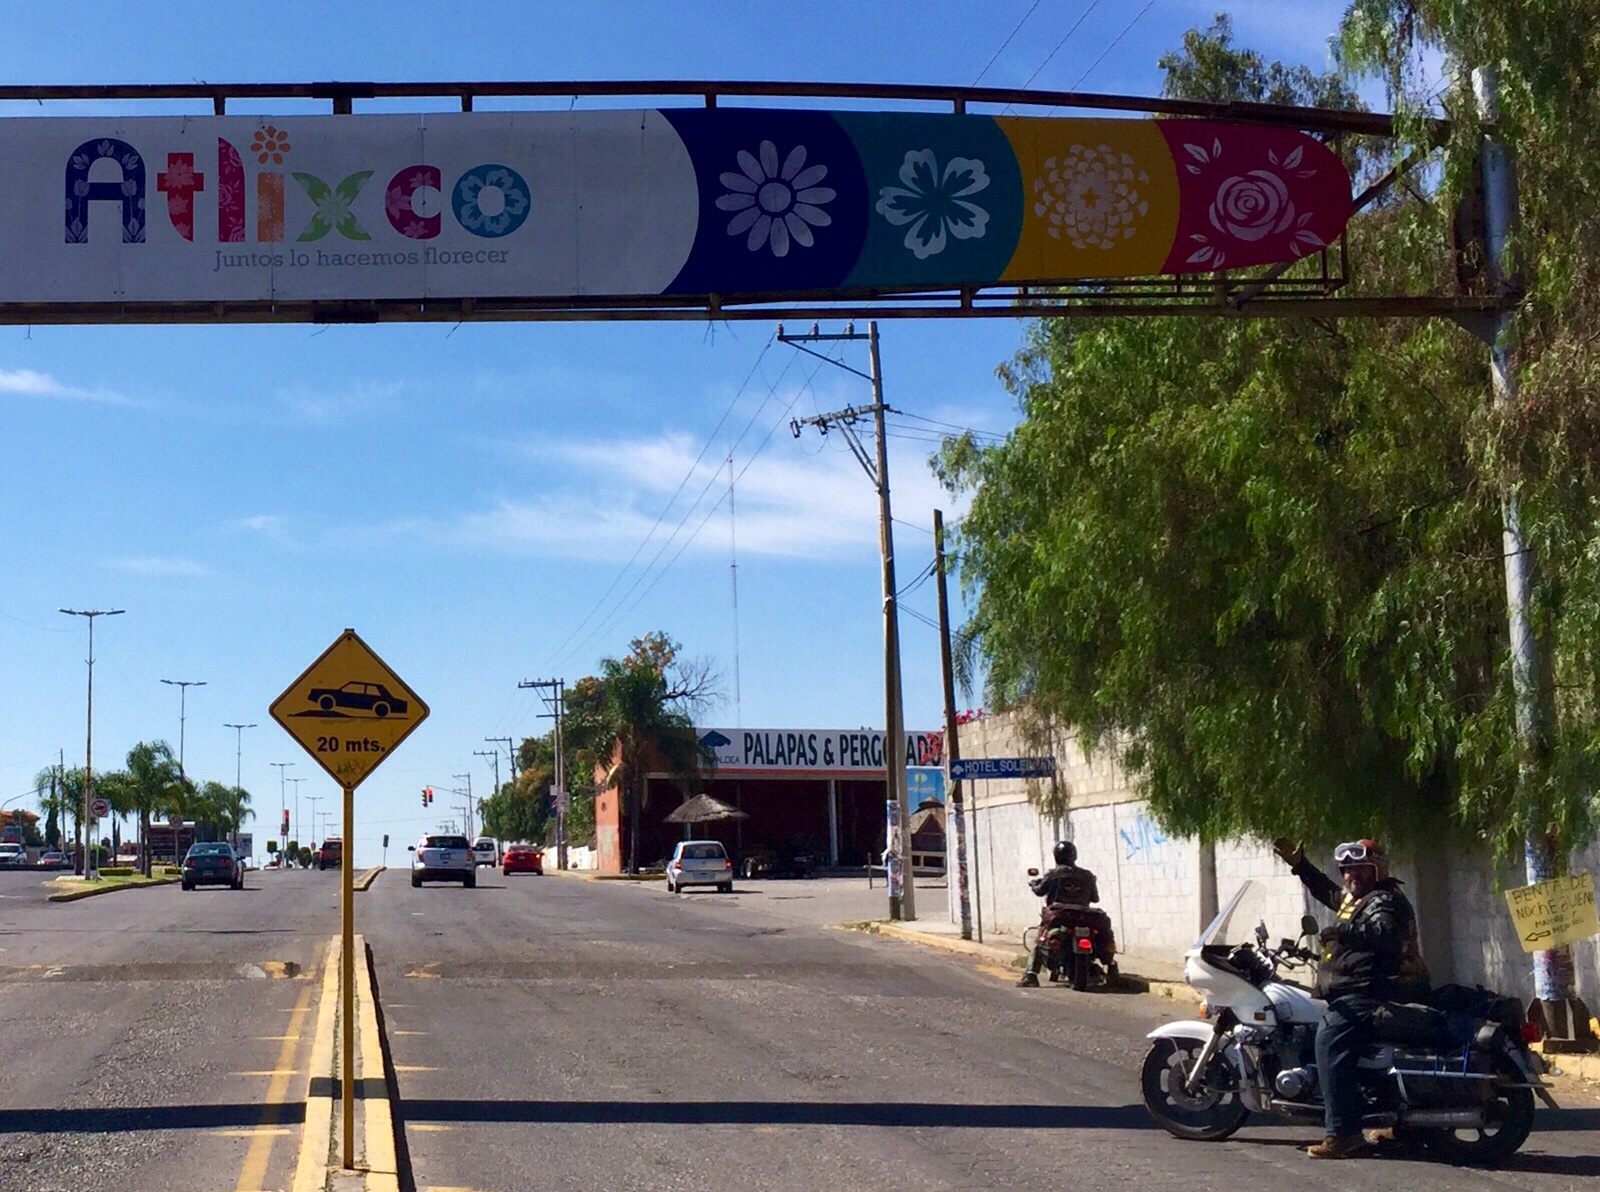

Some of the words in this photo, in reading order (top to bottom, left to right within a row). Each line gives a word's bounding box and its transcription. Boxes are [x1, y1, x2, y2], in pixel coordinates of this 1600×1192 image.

[65, 125, 531, 243] Atlixco
[213, 249, 284, 272] Juntos
[289, 248, 310, 268] lo
[316, 248, 418, 268] hacemos
[423, 246, 510, 267] florecer
[317, 736, 339, 752] 20
[345, 736, 386, 752] mts.
[743, 732, 818, 766] PALAPAS
[823, 737, 835, 766] &
[964, 761, 998, 773] HOTEL
[1570, 872, 1589, 891] DE
